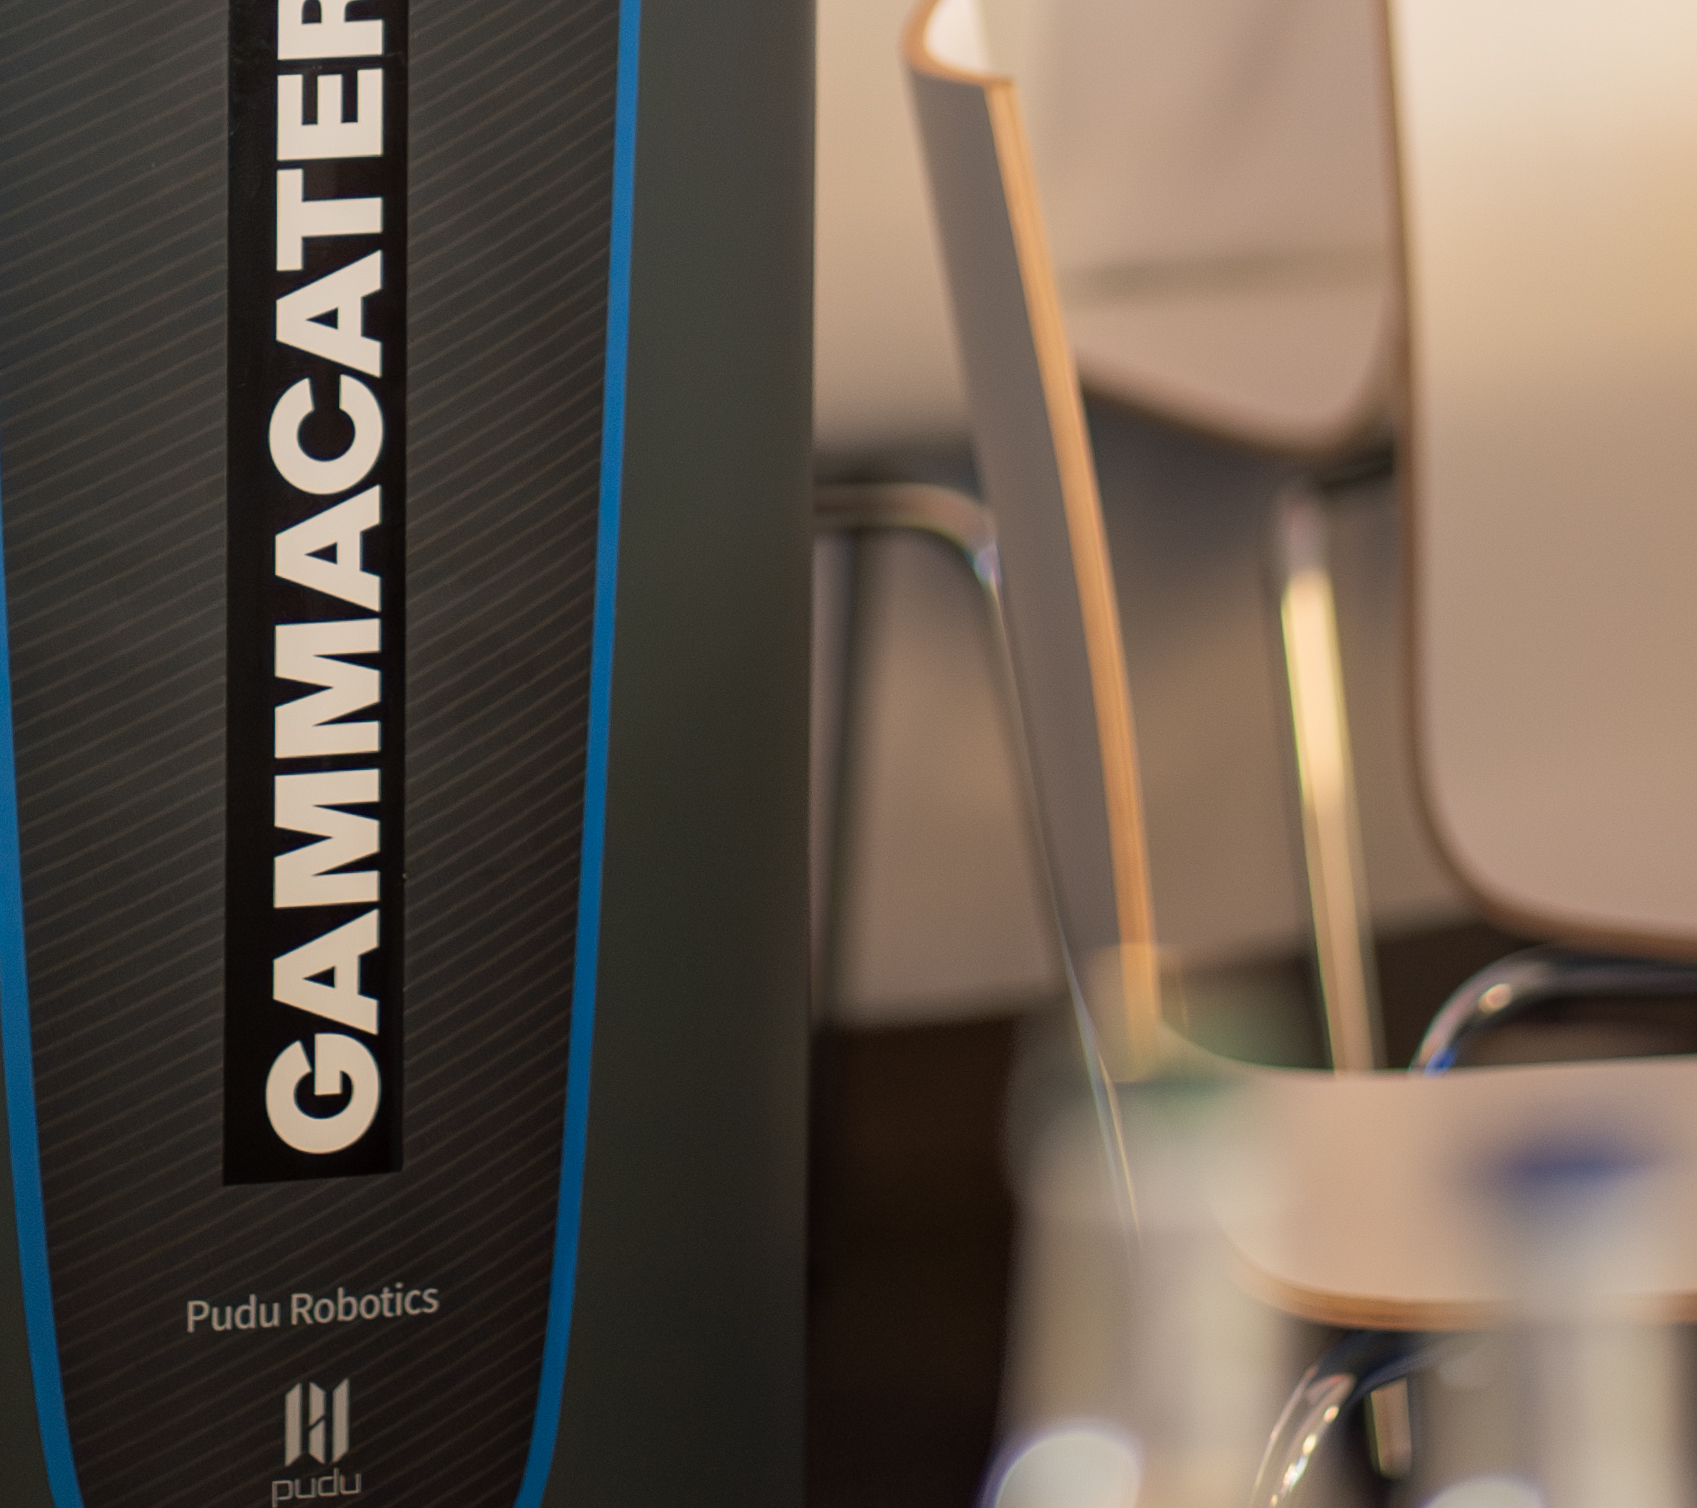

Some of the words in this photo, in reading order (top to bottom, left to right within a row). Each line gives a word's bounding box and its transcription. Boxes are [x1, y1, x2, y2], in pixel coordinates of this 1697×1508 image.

[186, 1294, 281, 1333] Pudu
[290, 1282, 440, 1326] Robotics
[271, 1468, 362, 1508] pudu
